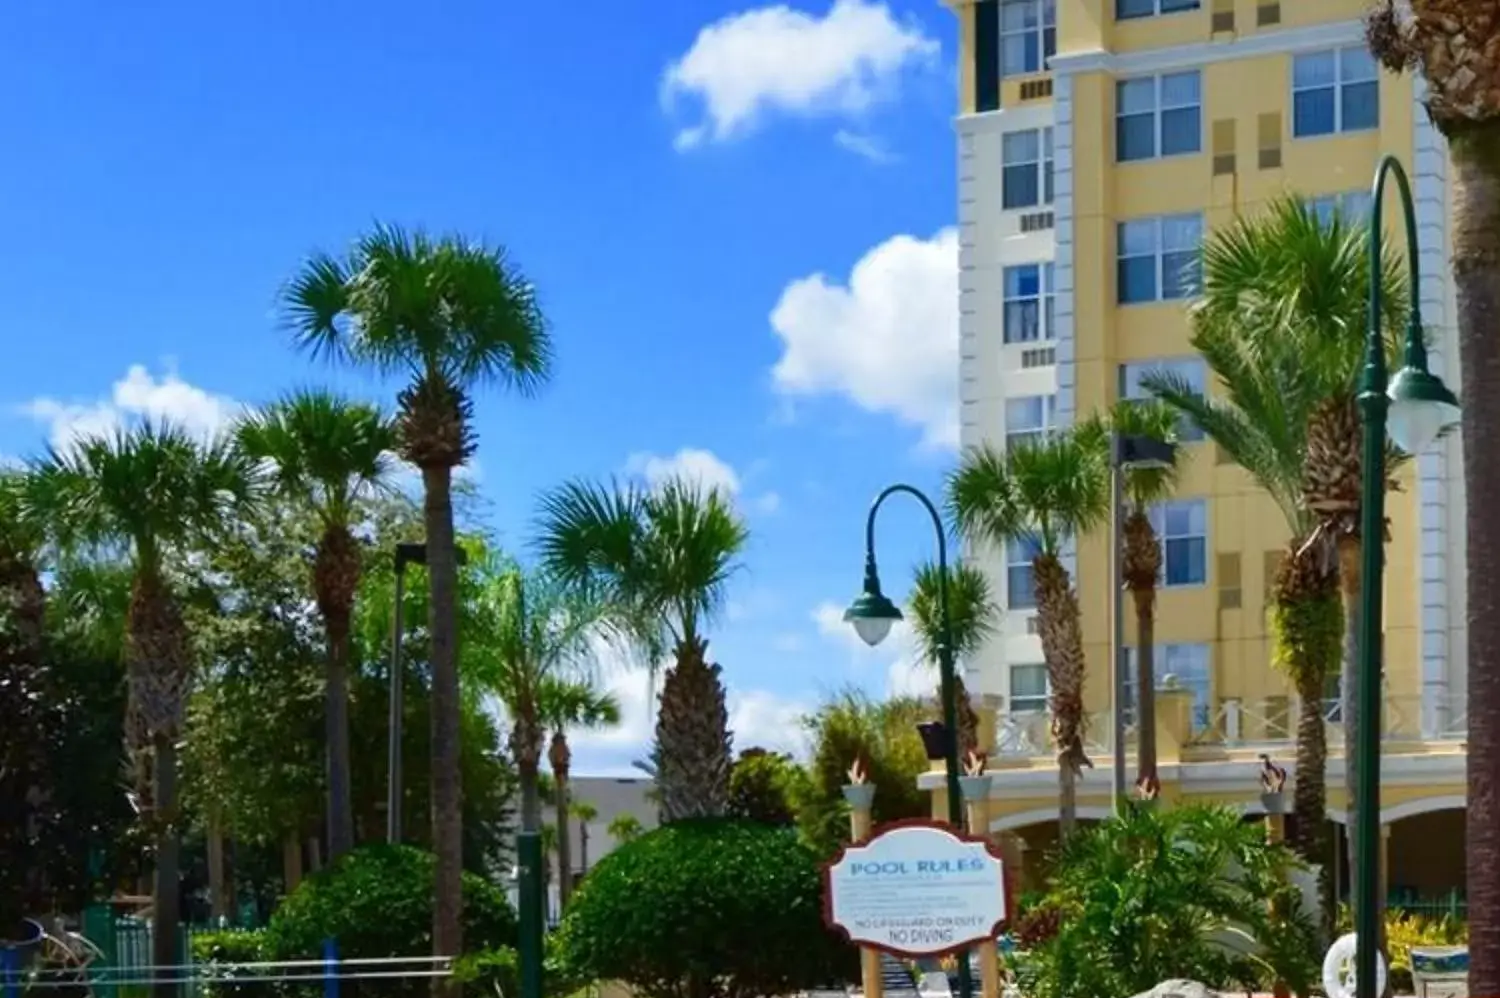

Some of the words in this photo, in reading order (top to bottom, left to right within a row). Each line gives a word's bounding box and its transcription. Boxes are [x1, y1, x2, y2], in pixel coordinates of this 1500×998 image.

[851, 861, 909, 875] POOL
[917, 858, 985, 872] RULES
[889, 930, 908, 944] NO
[911, 928, 954, 943] DIVING
